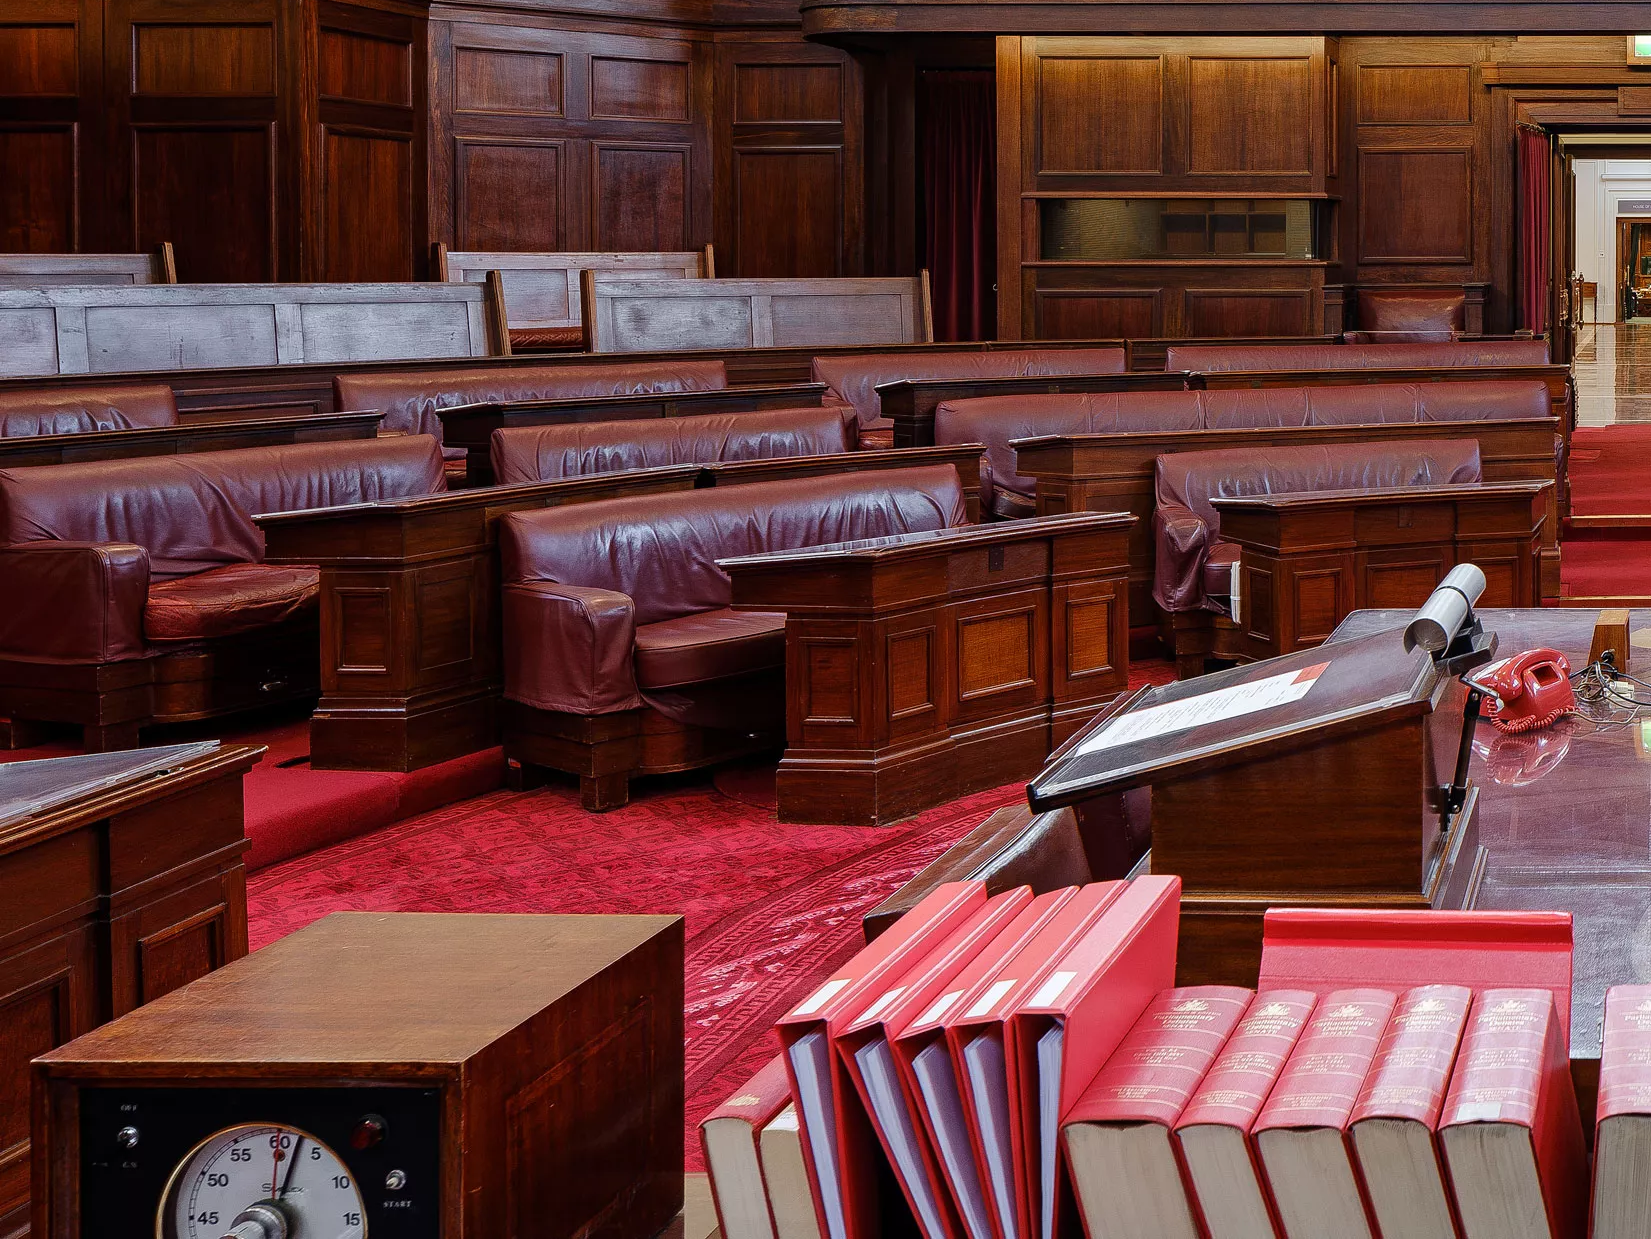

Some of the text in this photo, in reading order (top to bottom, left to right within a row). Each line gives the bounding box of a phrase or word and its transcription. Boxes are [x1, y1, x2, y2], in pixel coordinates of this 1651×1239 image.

[269, 1135, 291, 1149] 60
[230, 1148, 251, 1162] 55
[310, 1147, 321, 1160] 5
[206, 1173, 229, 1187] 50
[331, 1176, 350, 1190] 10
[383, 1200, 412, 1208] START
[197, 1211, 219, 1225] 45
[342, 1212, 361, 1226] 15
